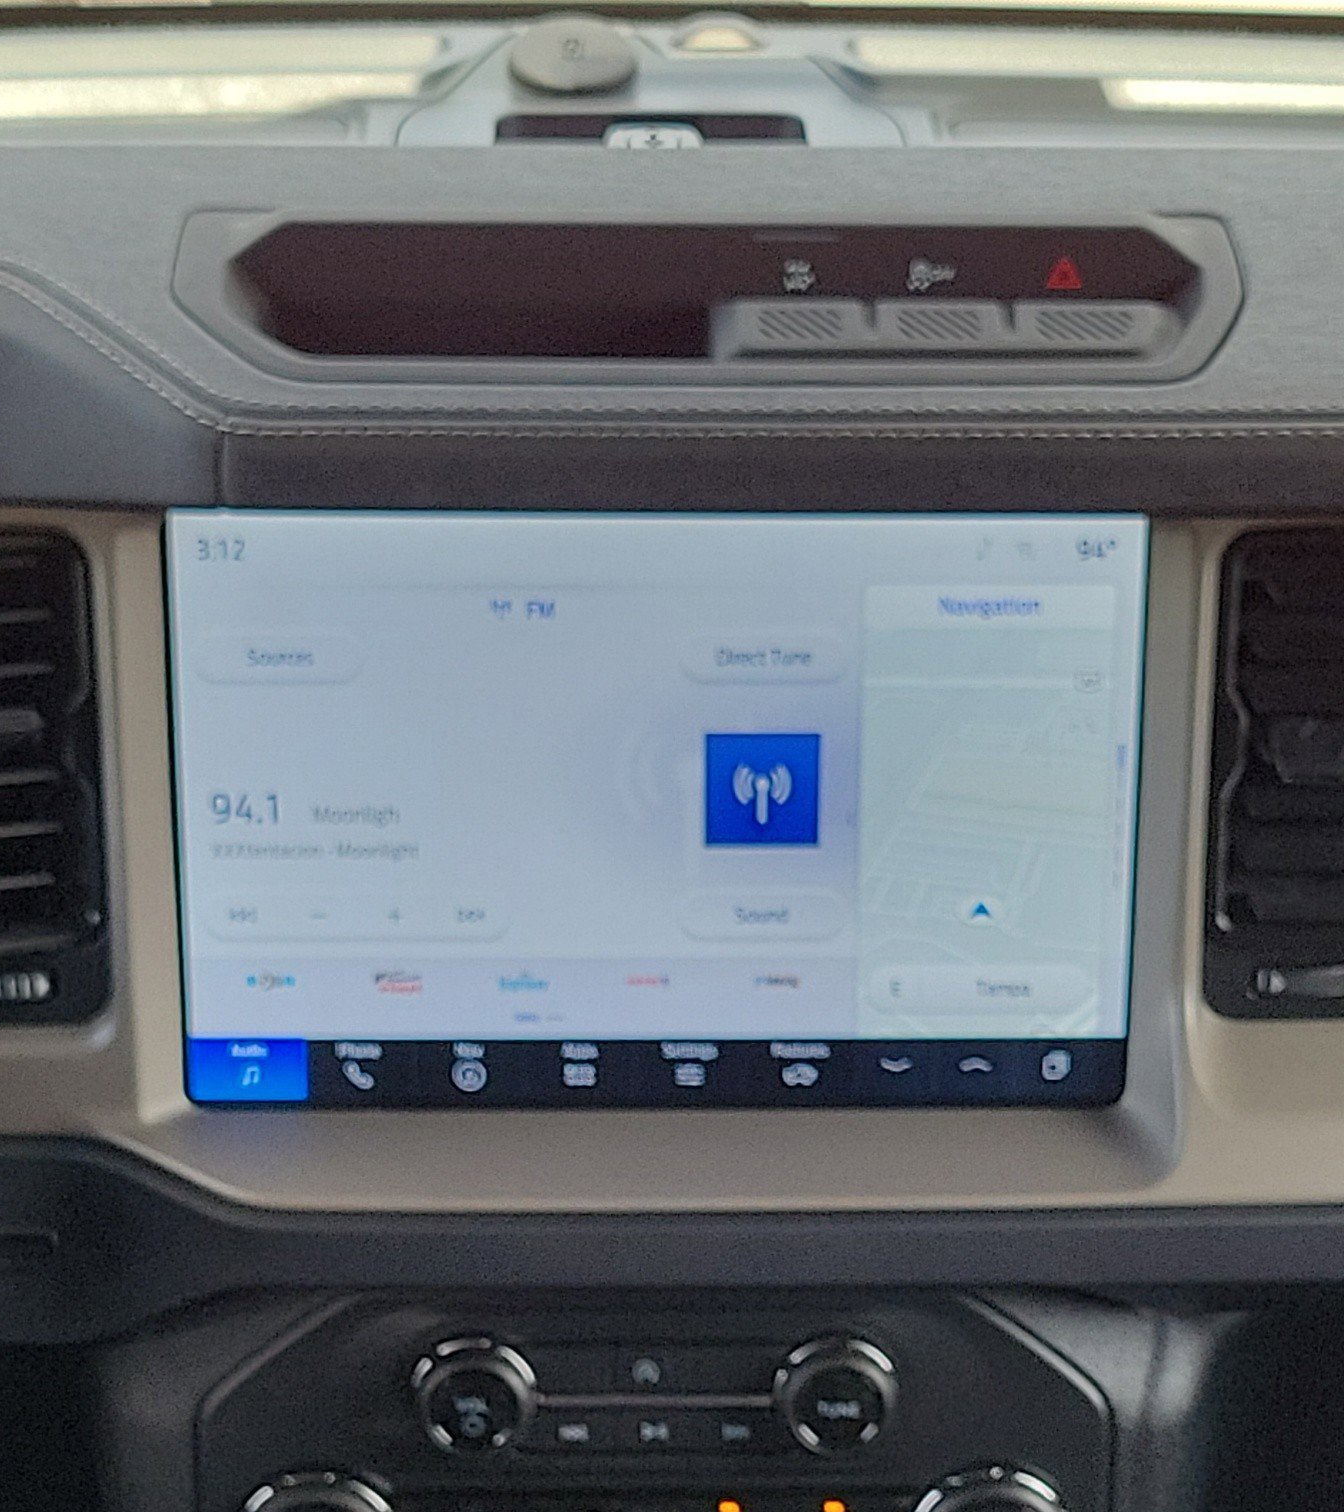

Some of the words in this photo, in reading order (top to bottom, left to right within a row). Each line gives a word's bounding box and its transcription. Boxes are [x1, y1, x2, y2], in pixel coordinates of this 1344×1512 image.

[197, 539, 247, 562] 3:12
[937, 596, 1044, 619] Navigation
[212, 793, 281, 825] 94.1
